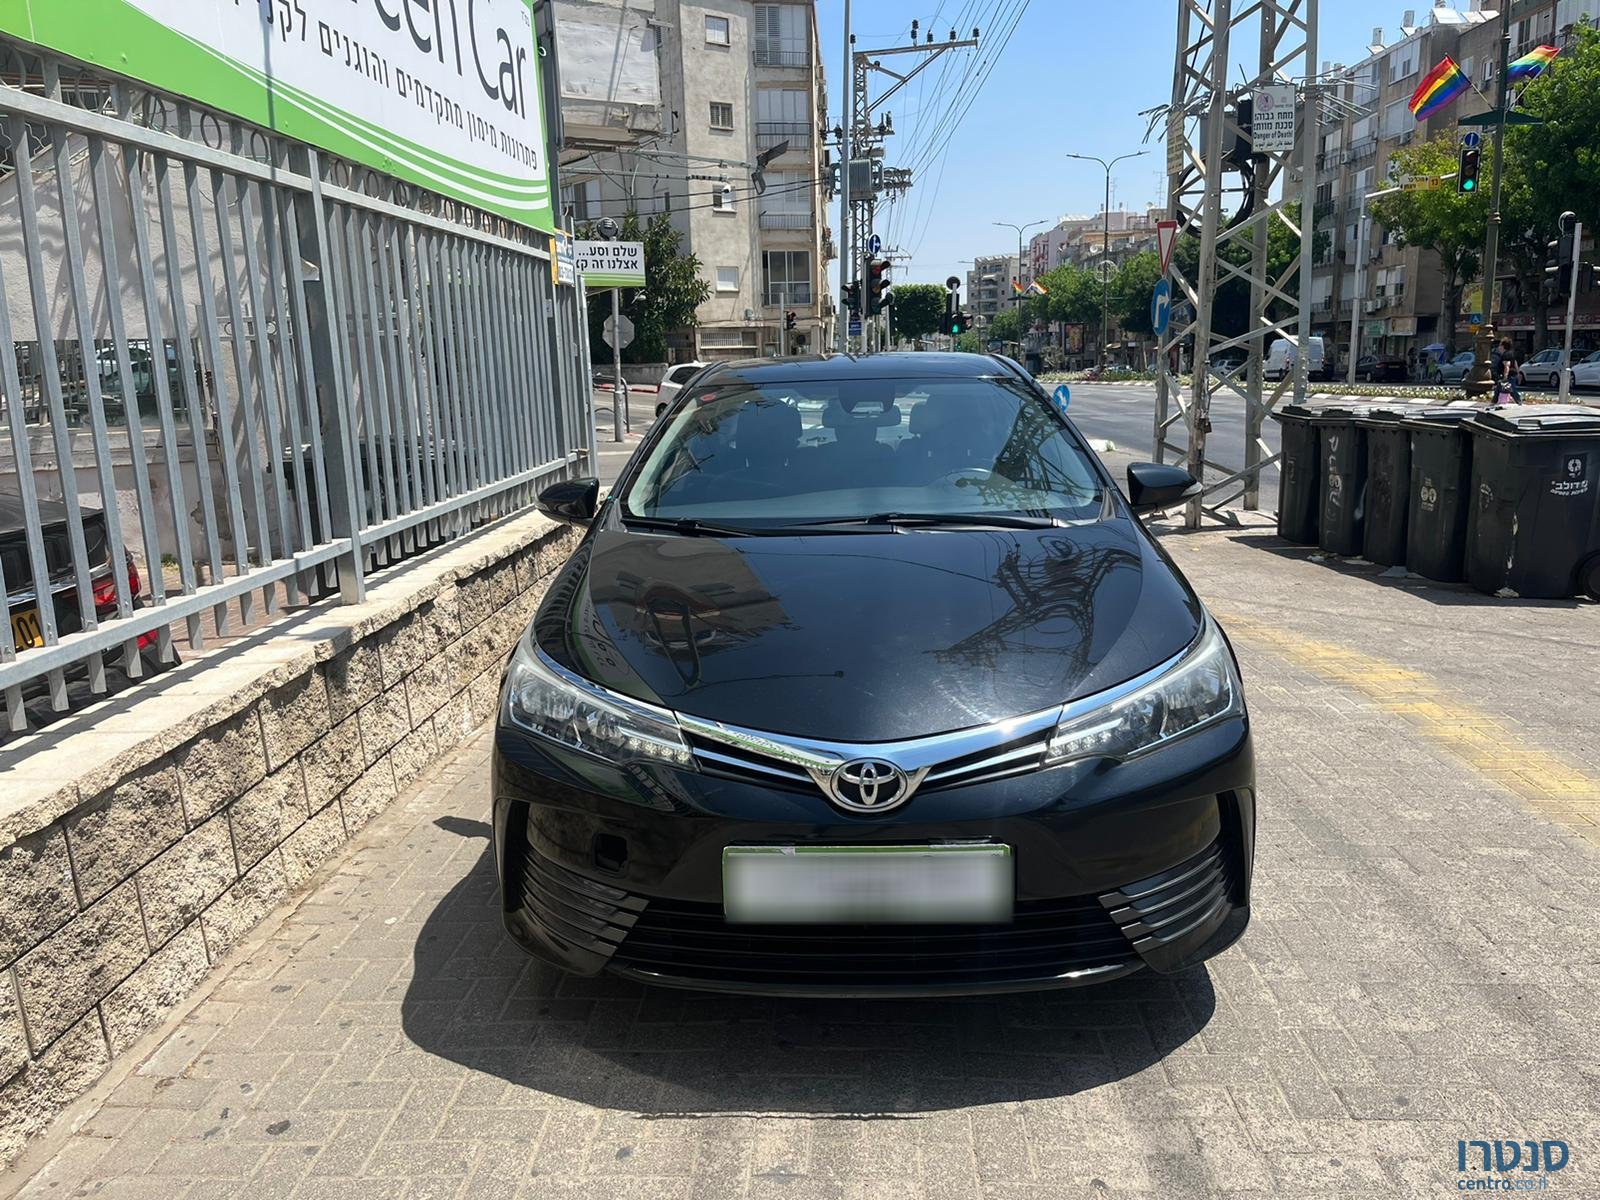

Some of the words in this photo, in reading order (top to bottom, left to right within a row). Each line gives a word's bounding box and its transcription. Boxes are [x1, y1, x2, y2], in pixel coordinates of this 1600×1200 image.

[318, 20, 389, 88] והוגנים
[468, 0, 526, 120] Car
[396, 67, 463, 130] מתקדמים
[1277, 111, 1293, 120] מתח
[467, 110, 497, 149] מימון
[1275, 121, 1293, 130] סכנת
[1253, 131, 1271, 141] Danger
[1271, 130, 1277, 138] of
[500, 131, 537, 171] פתרונות
[578, 247, 609, 256] וסע...
[613, 245, 637, 257] שלם
[592, 259, 605, 269] זה
[608, 258, 638, 269] אצלנו
